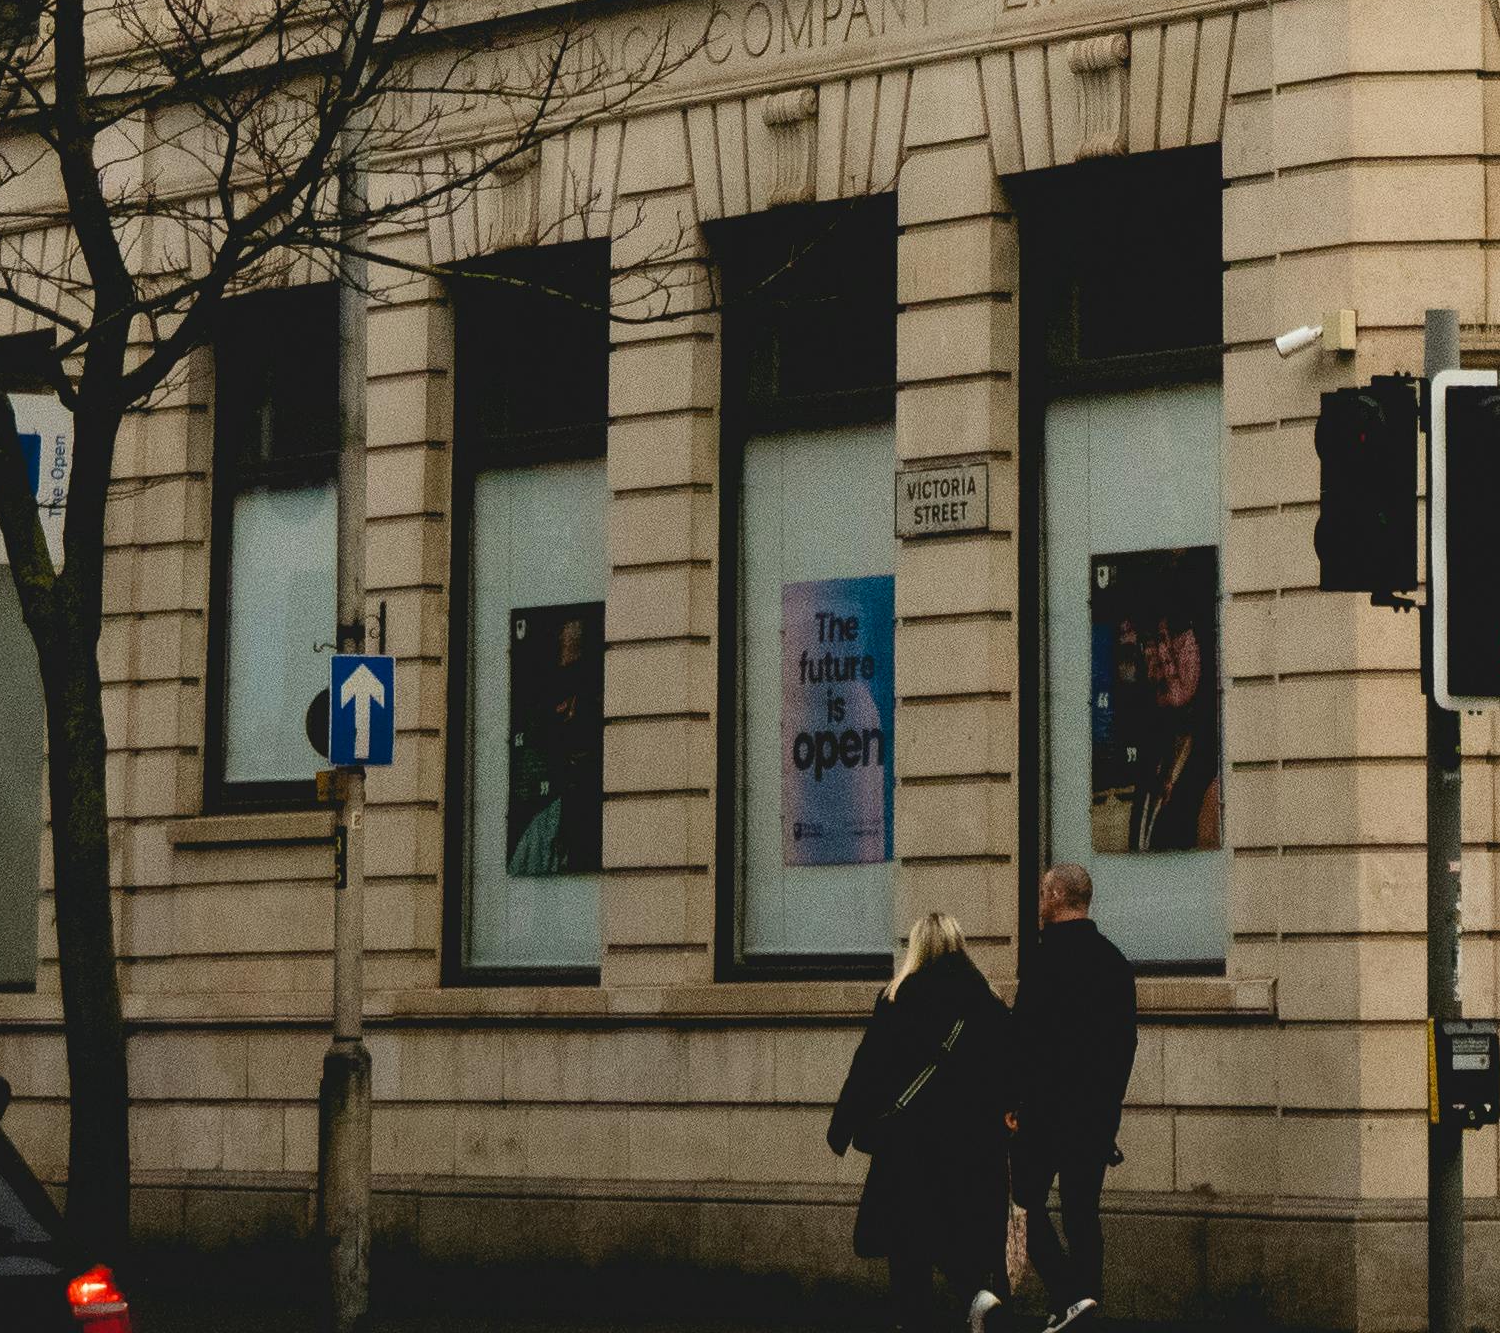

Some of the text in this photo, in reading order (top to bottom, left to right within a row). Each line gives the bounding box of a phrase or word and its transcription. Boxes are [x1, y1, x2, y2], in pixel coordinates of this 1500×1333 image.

[51, 434, 68, 480] Open
[906, 475, 977, 501] VICTORIA
[913, 501, 969, 525] STREET
[815, 611, 859, 643] The
[799, 649, 876, 685] future
[826, 687, 847, 724] is
[793, 727, 885, 782] open
